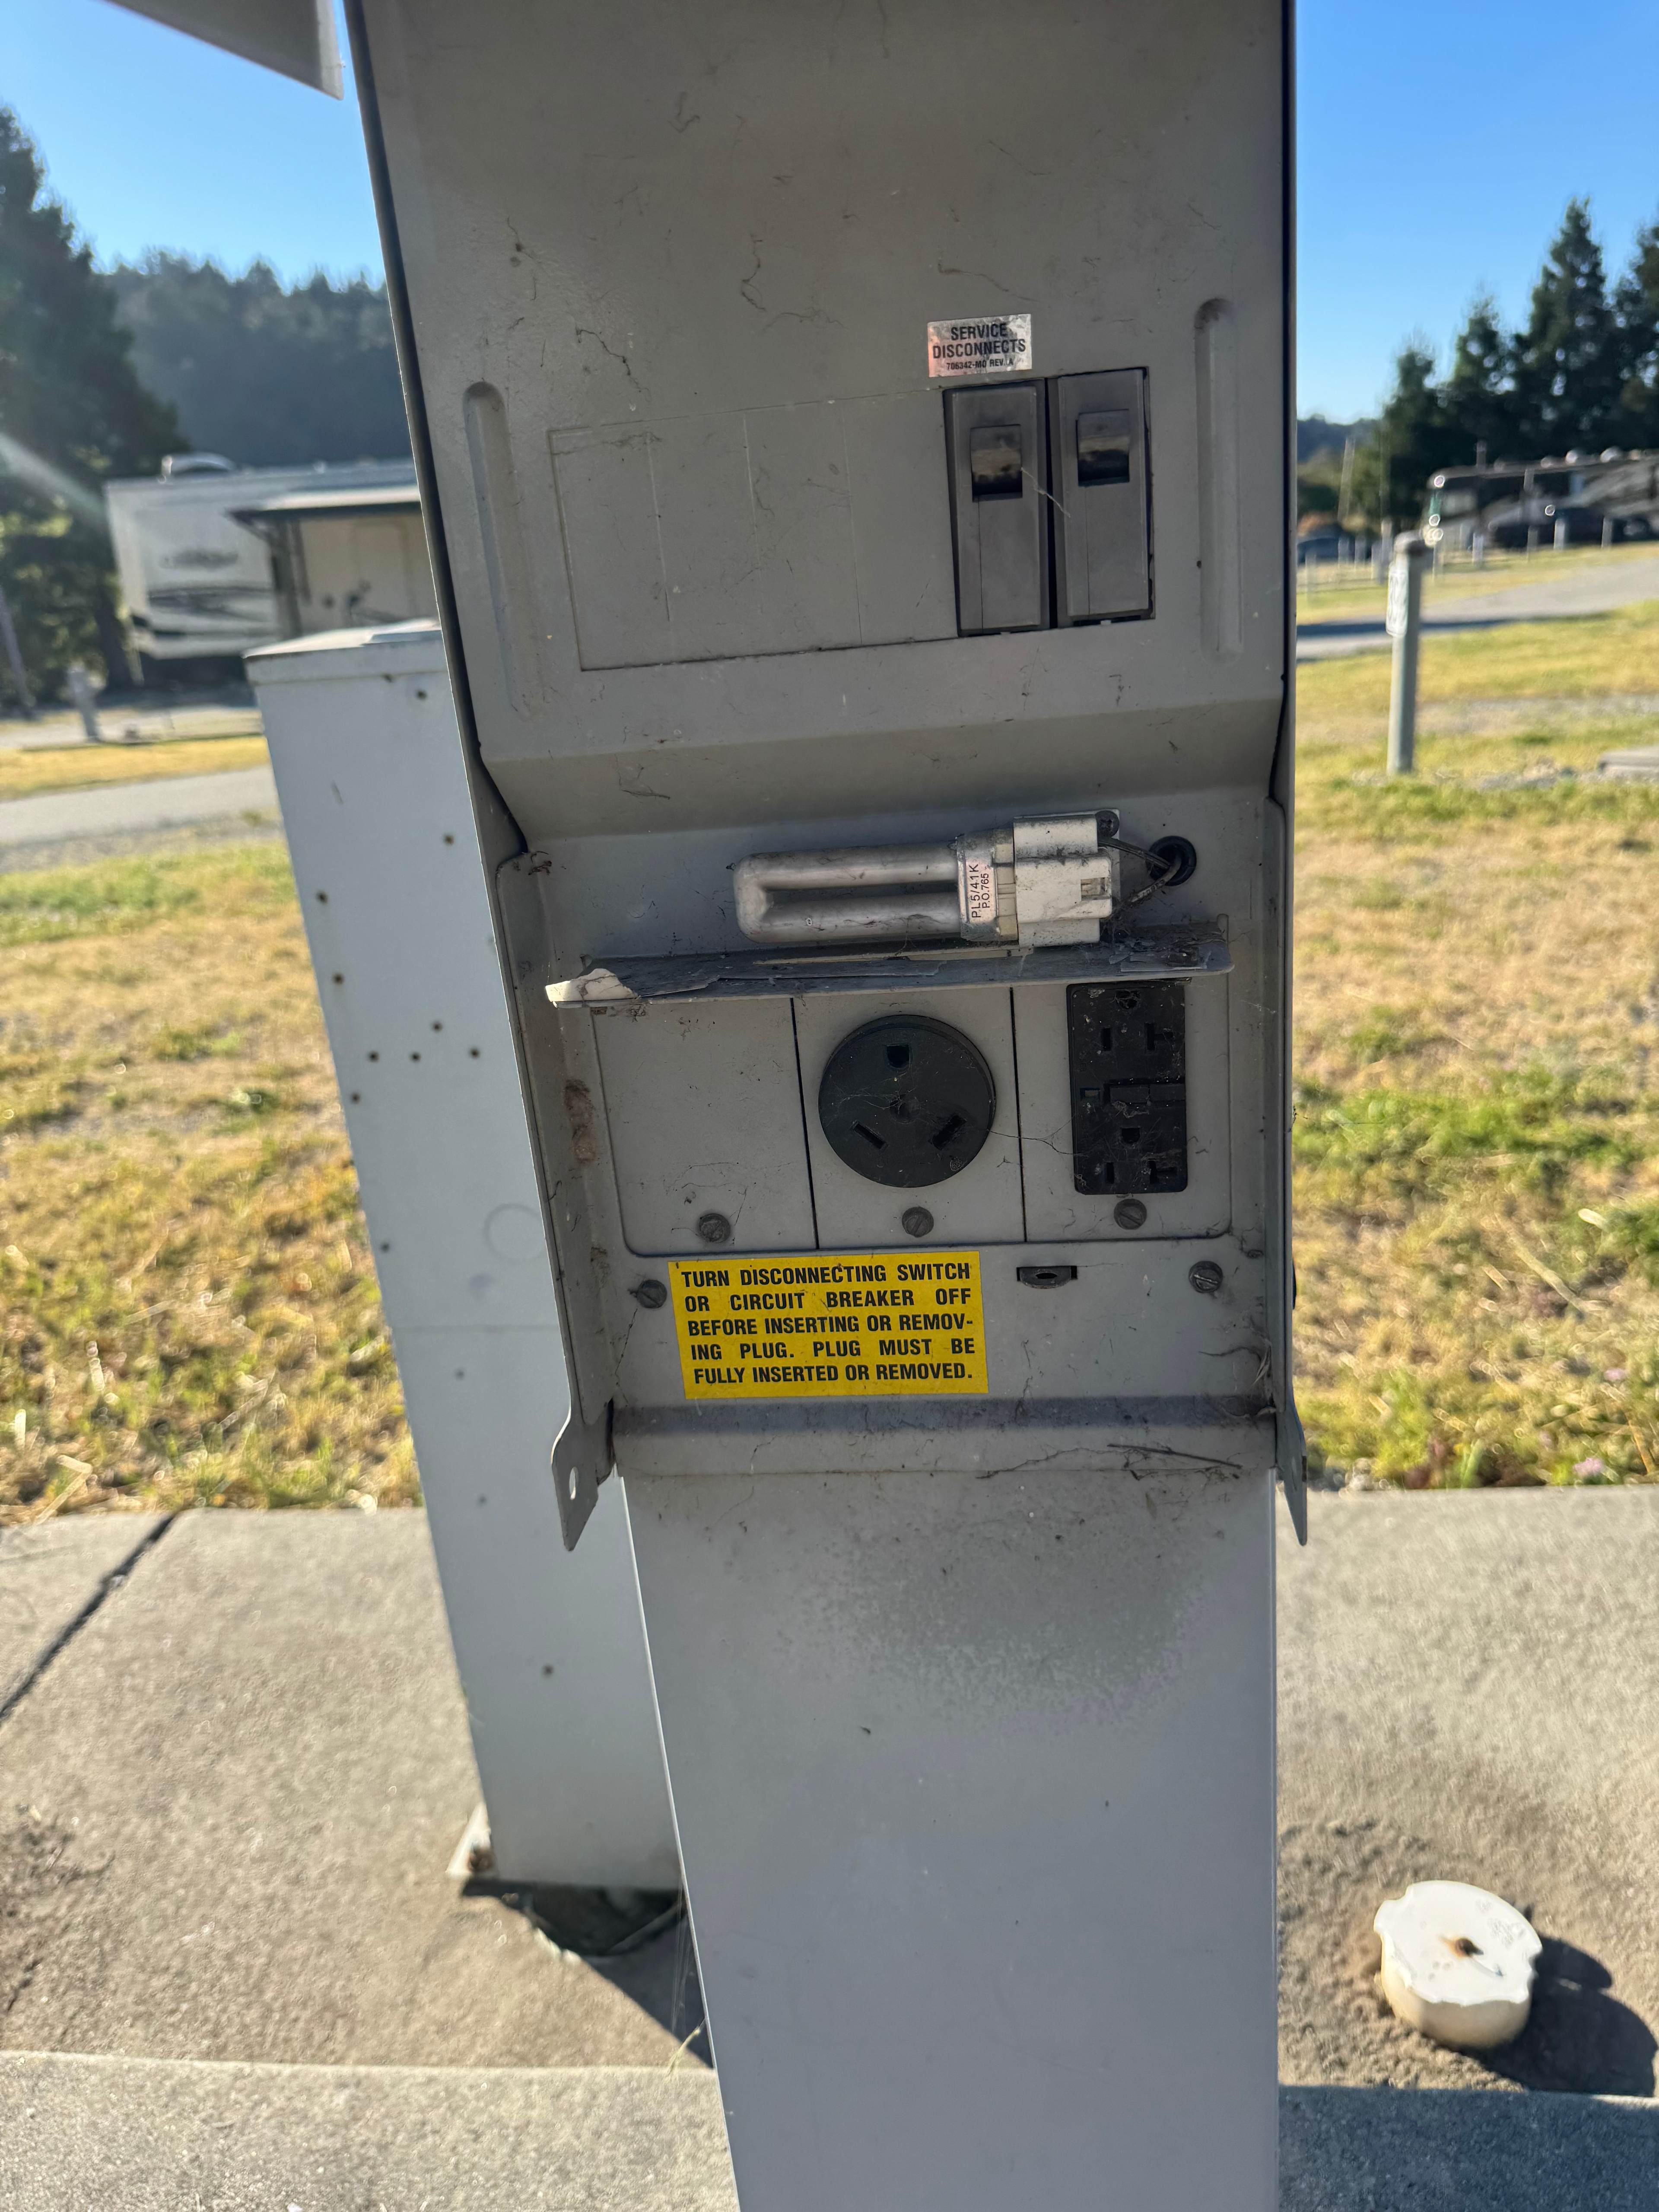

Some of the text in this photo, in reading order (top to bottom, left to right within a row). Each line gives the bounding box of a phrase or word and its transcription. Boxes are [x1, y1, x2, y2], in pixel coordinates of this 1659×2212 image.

[950, 323, 1007, 341] SERVICE
[932, 338, 1026, 359] DISCONNECTS
[1009, 358, 1014, 366] A
[969, 864, 981, 918] PL5/41K
[681, 1262, 970, 1287] TURN DISCONNECTING SWITCH
[685, 1288, 971, 1312] OR CIRCUIT BREAKER OFF
[687, 1313, 973, 1336] BEFORE INSERTING OR REMOV-
[691, 1338, 975, 1360] ING PLUG. PLUG MUST BE
[694, 1363, 972, 1384] FULLY INSERTED OR REMOVED.
